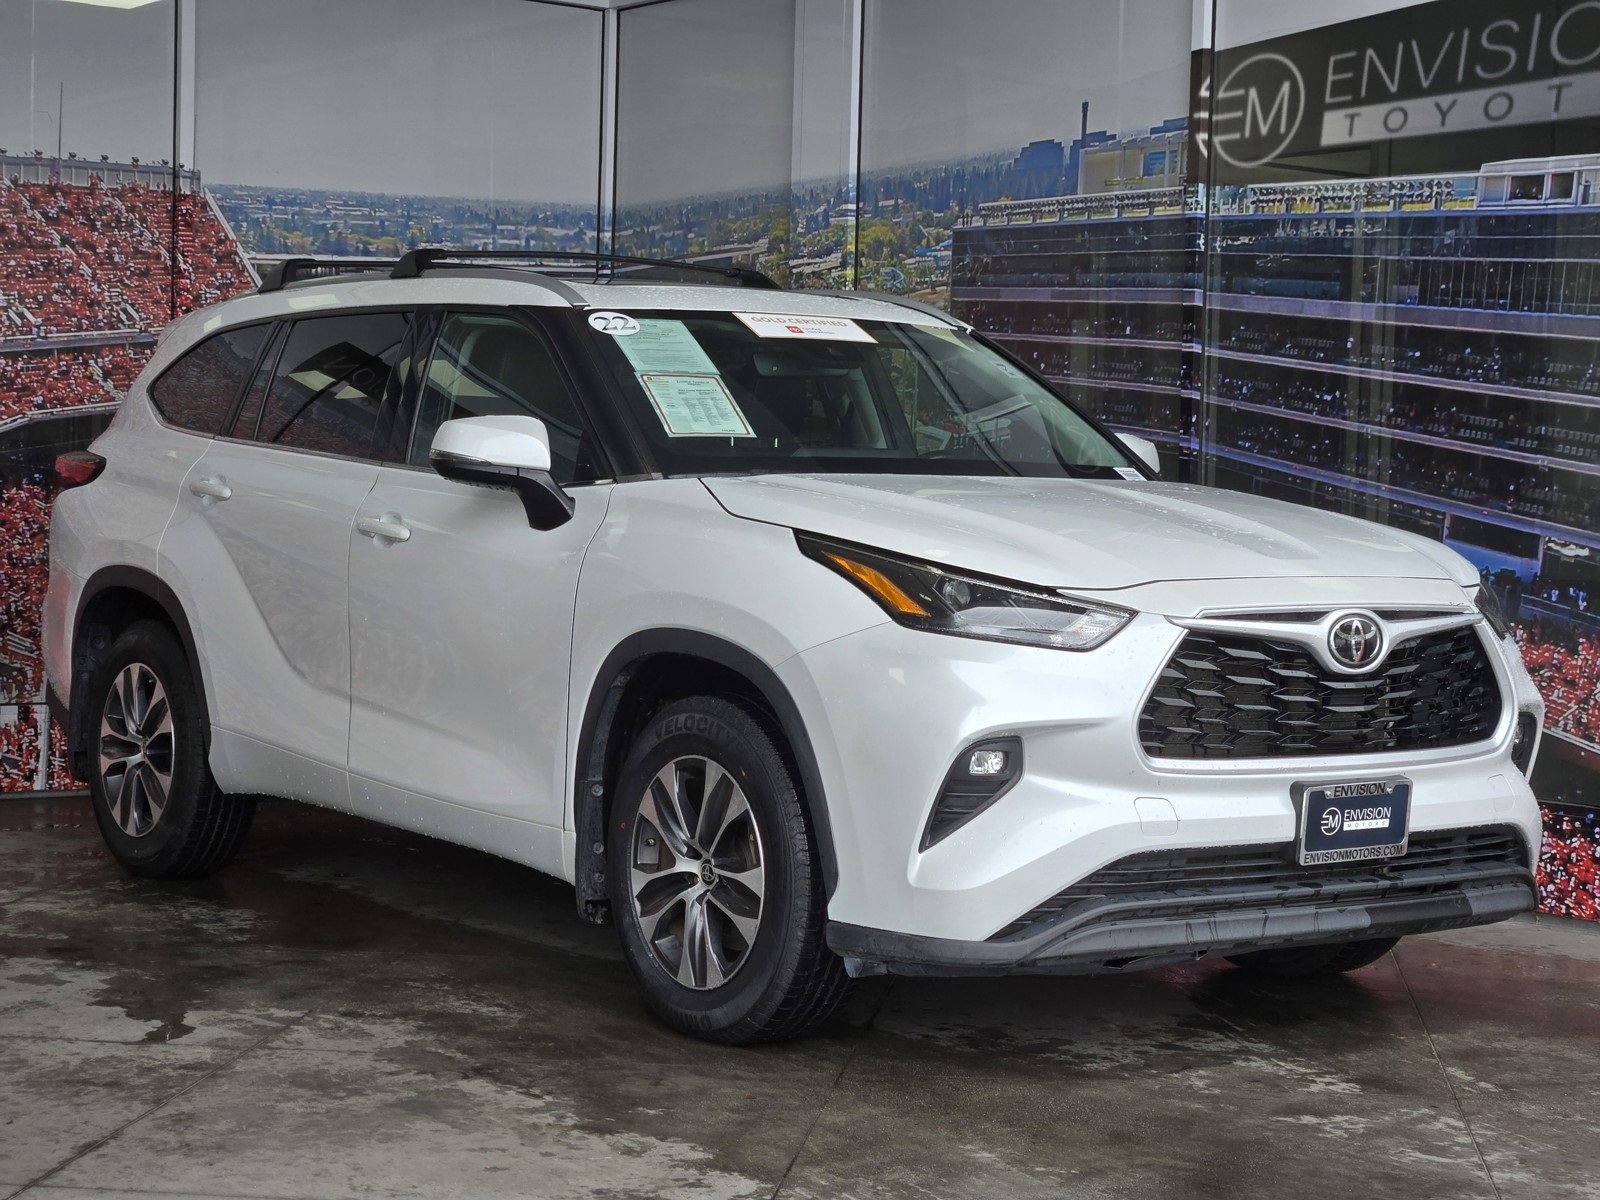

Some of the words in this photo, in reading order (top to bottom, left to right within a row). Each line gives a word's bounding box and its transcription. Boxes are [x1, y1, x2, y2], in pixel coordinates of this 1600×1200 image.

[593, 316, 637, 331] 22
[655, 714, 738, 744] VELOCITY
[1333, 783, 1386, 797] ENVISION
[1343, 806, 1392, 821] ENVISION
[1304, 845, 1403, 864] ENVISIONMOTORS.COM
